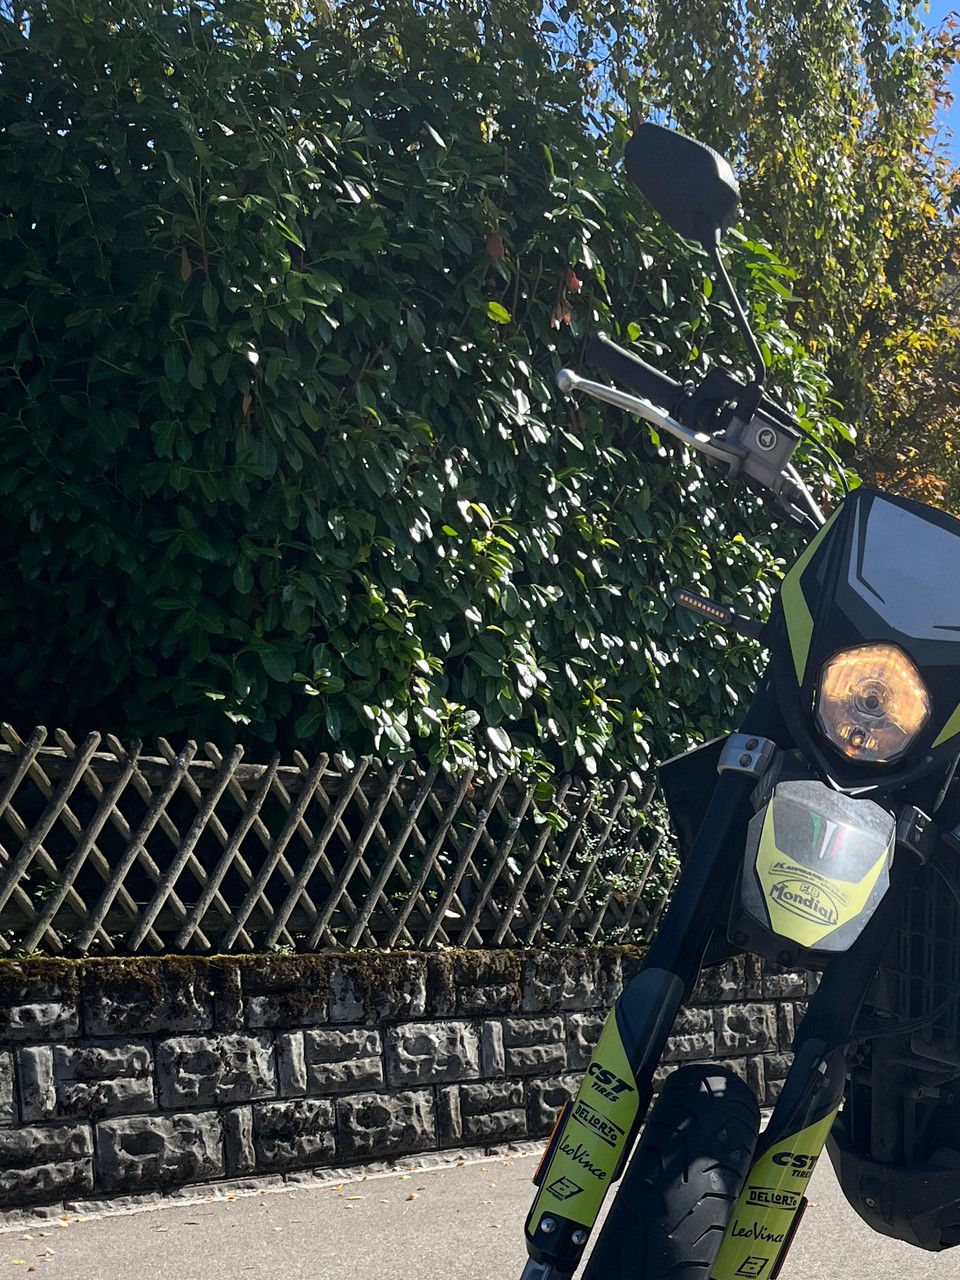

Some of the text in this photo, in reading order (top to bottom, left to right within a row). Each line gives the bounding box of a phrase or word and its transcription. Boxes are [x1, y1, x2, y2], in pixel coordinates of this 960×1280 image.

[769, 883, 834, 921] Mondial
[588, 1063, 635, 1094] CST
[591, 1082, 619, 1102] TIRES
[575, 1105, 617, 1141] DELLORTO
[559, 1135, 606, 1180] LeoVince
[772, 1152, 819, 1170] CST
